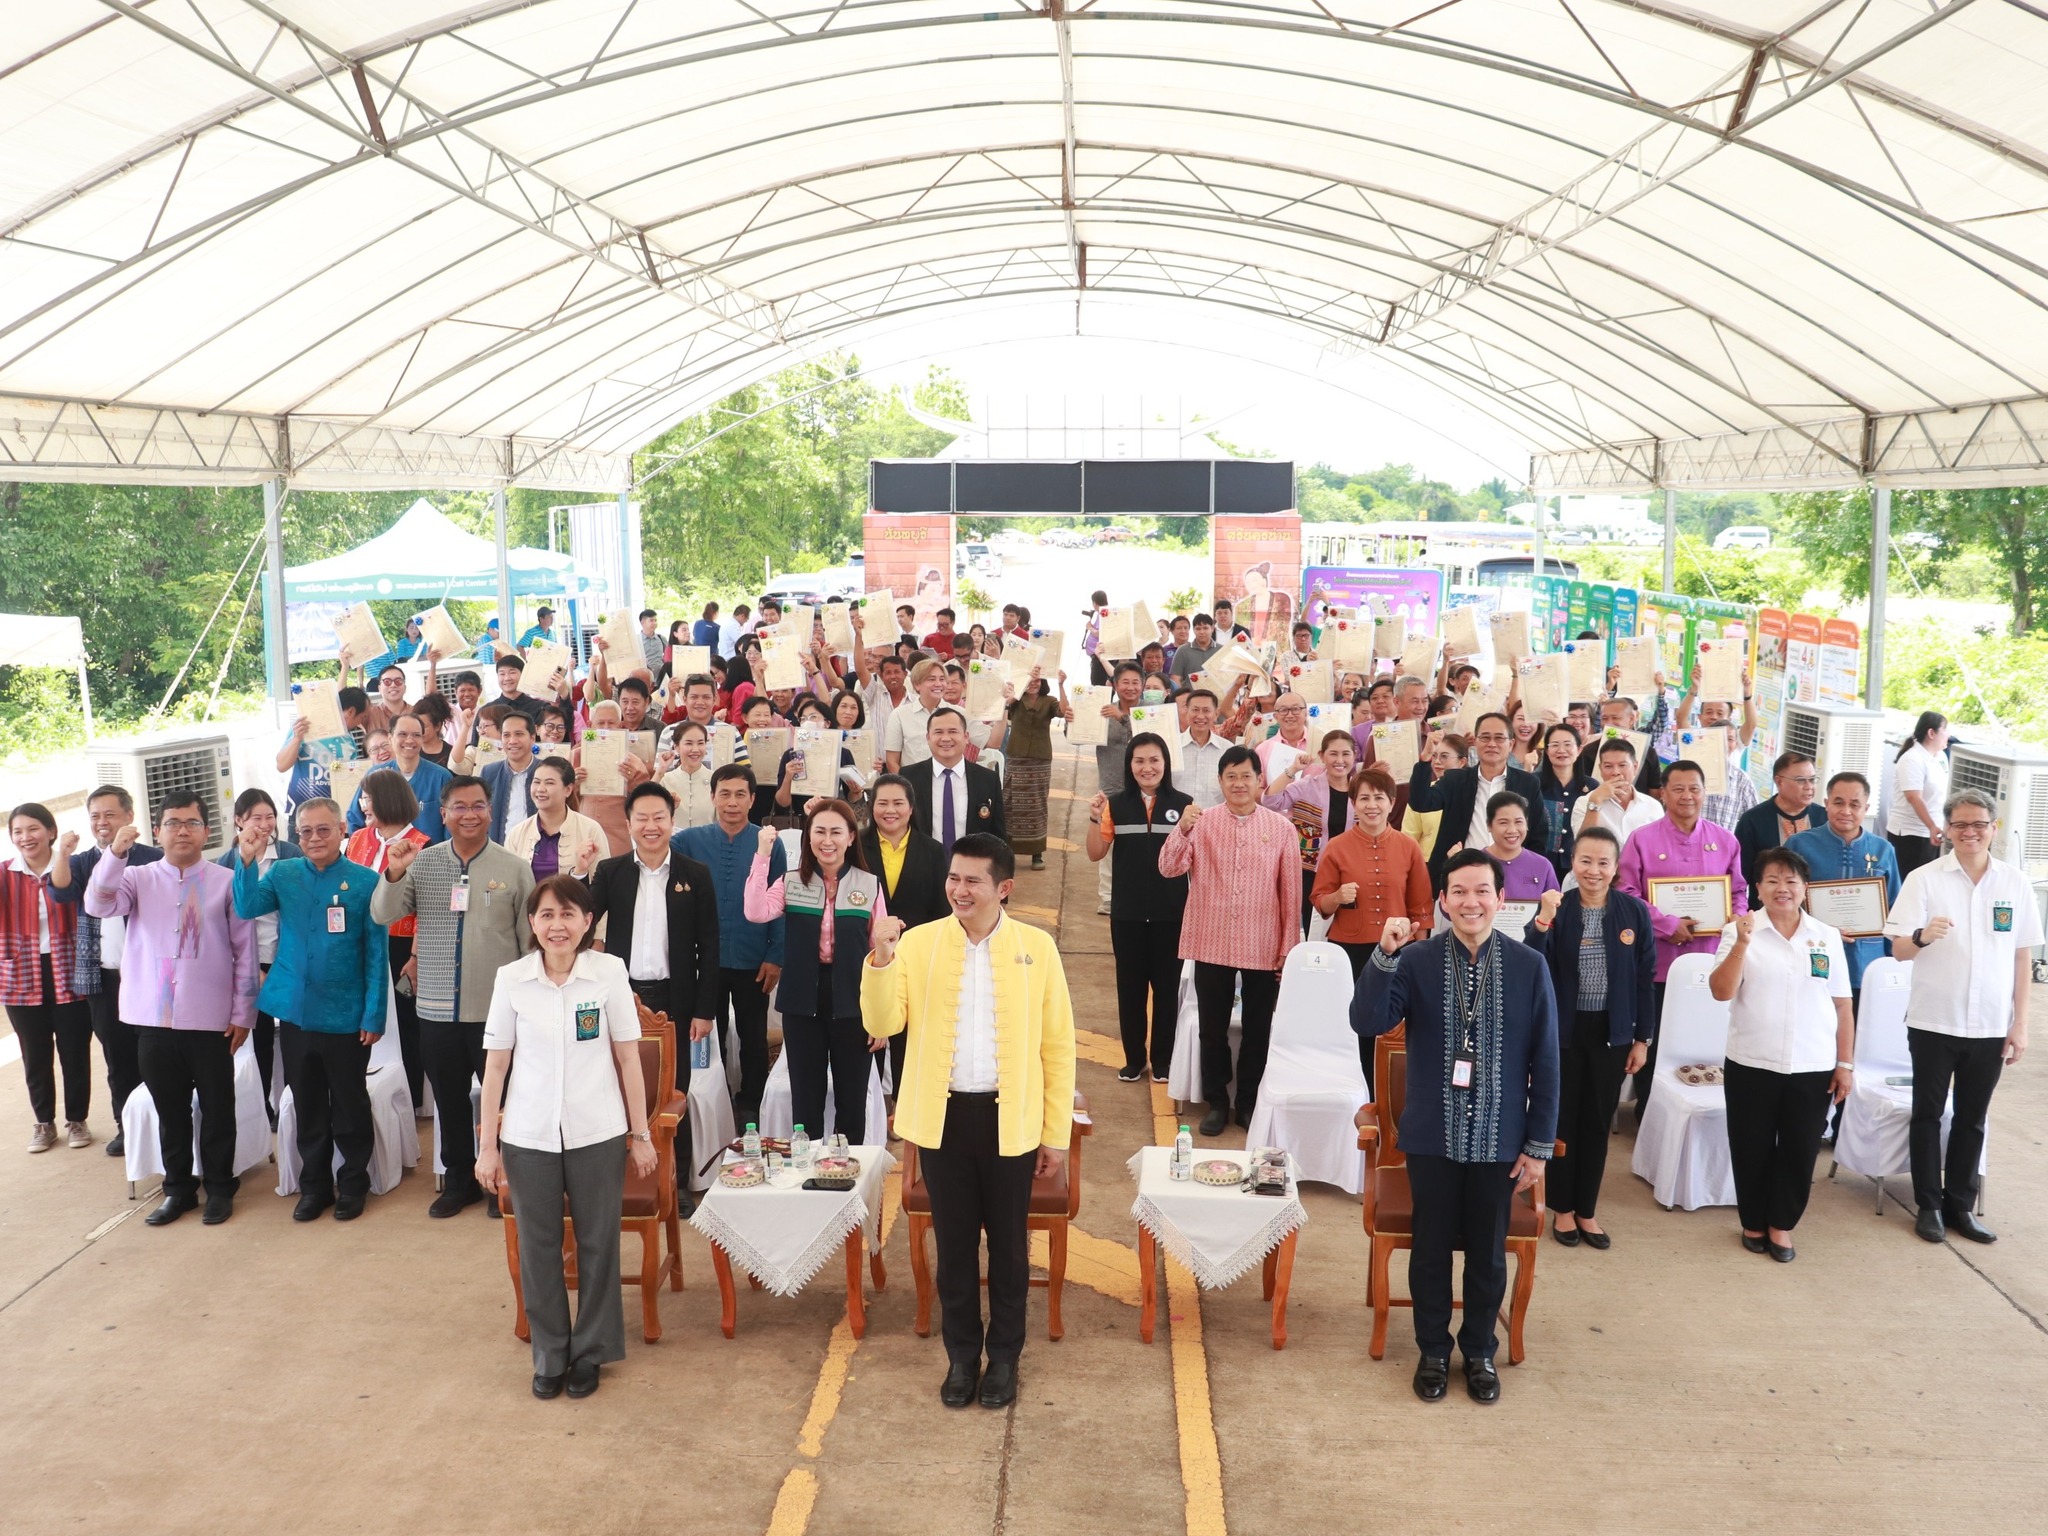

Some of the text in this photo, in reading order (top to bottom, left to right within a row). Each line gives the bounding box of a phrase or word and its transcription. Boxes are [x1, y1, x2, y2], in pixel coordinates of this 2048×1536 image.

[884, 527, 928, 545] นันทบุรี
[1226, 527, 1292, 541] ศรีนครน่าน
[1314, 956, 1320, 965] 4
[1699, 974, 1705, 983] 2
[577, 1001, 597, 1010] DPT
